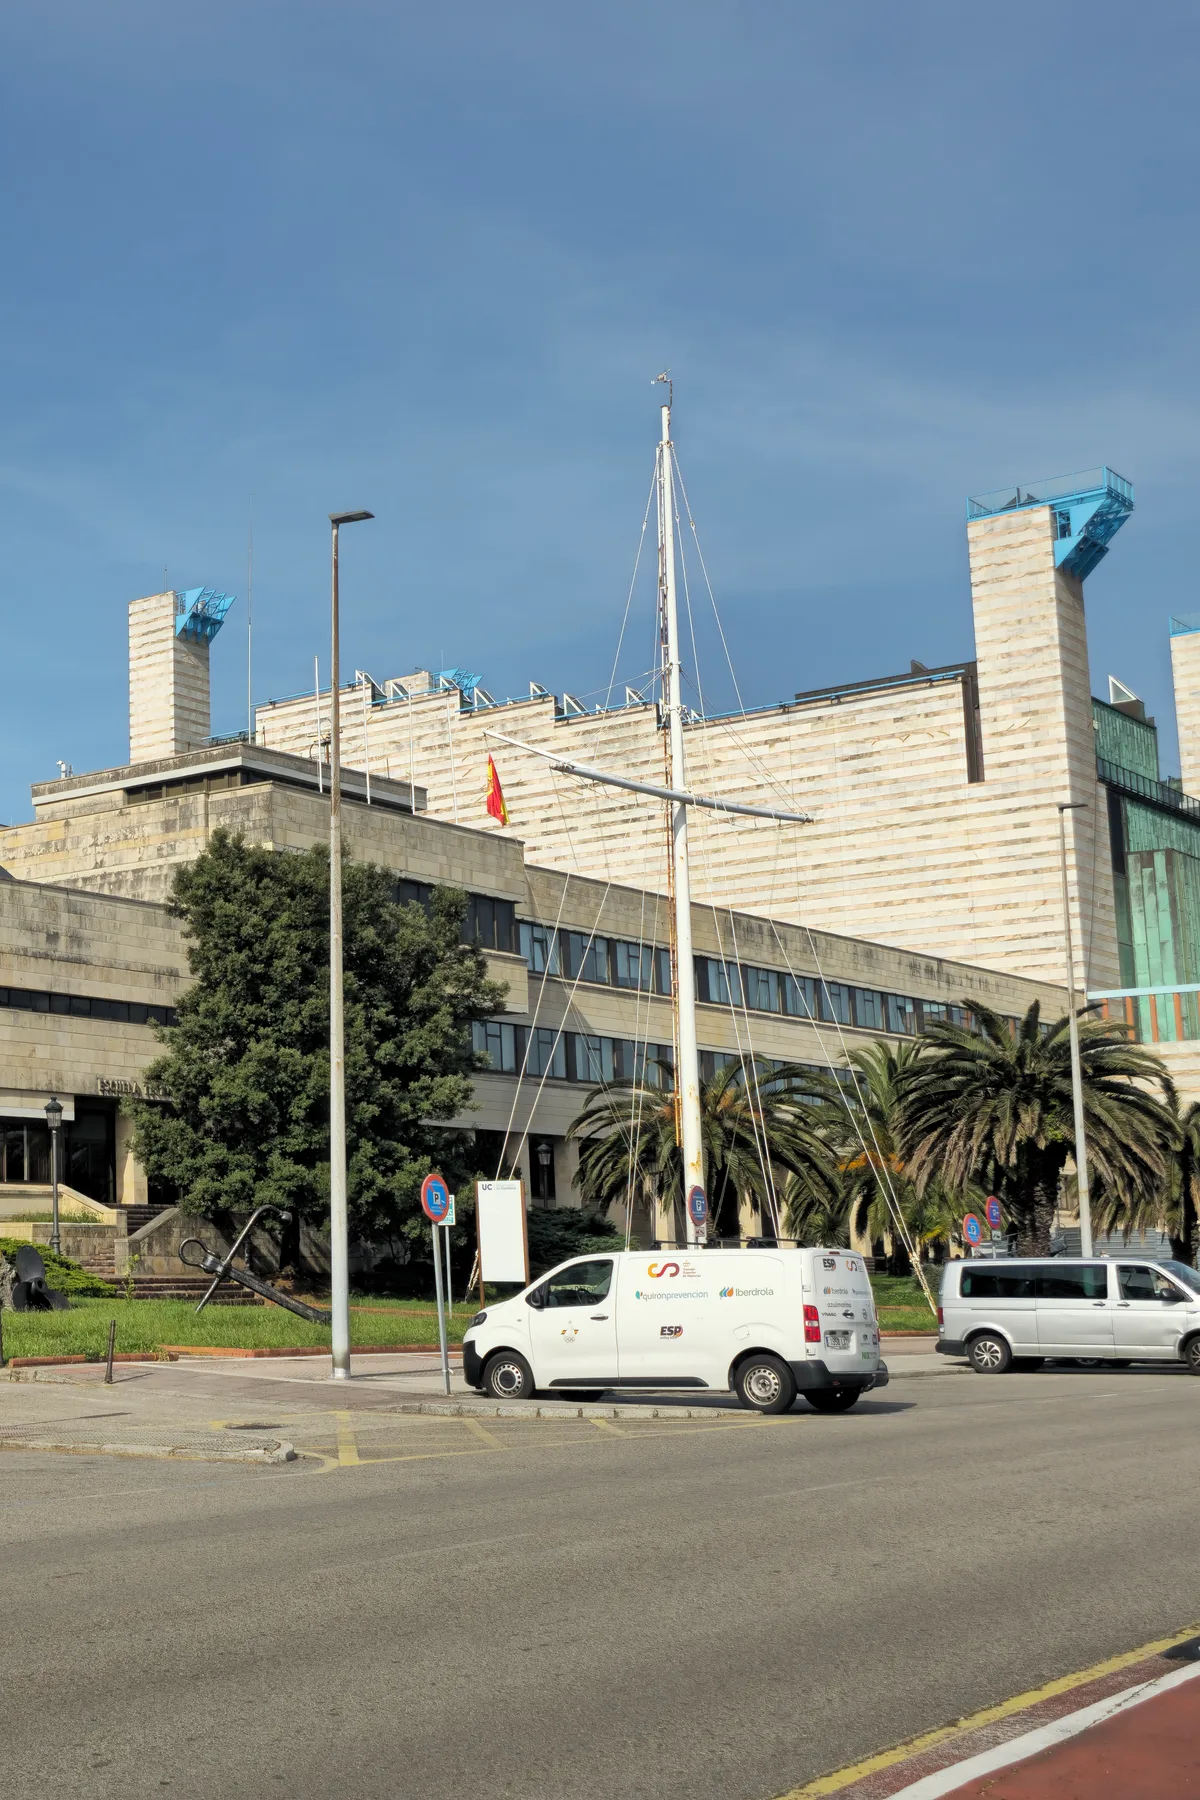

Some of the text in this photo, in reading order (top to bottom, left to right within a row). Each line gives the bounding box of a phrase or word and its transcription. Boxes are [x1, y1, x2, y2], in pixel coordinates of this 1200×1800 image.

[434, 1193, 440, 1202] P
[735, 1288, 774, 1297] Iberdrola
[660, 1325, 682, 1336] ESP
